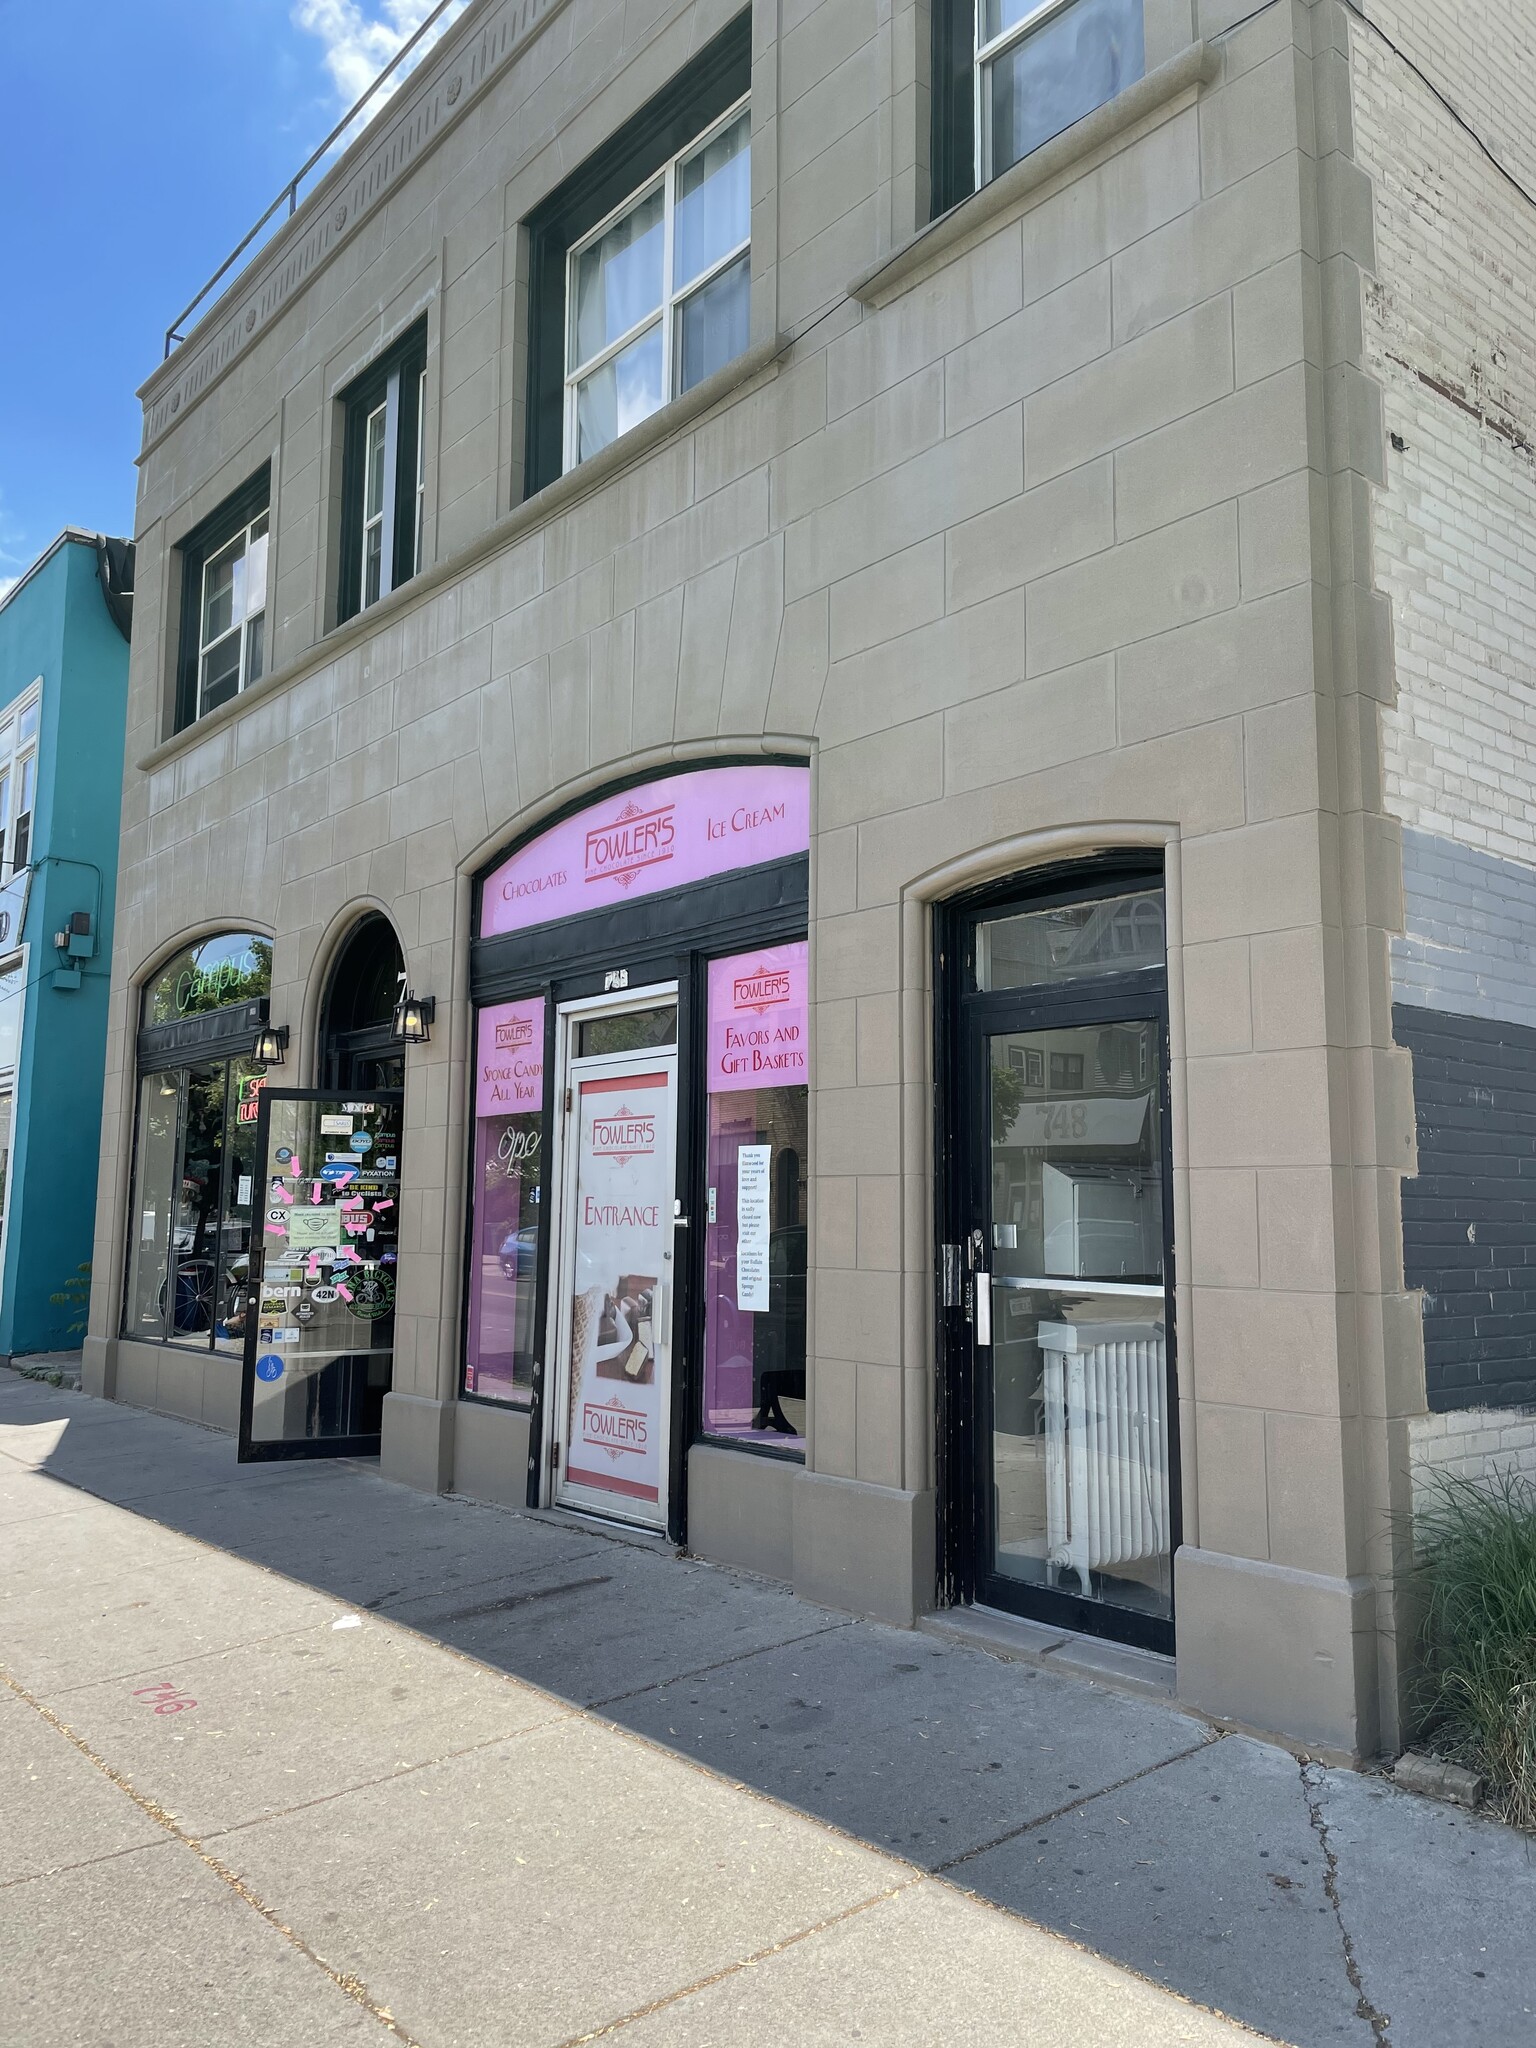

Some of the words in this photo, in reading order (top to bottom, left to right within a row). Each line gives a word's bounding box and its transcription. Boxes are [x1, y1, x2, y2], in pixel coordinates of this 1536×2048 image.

[708, 818, 726, 840] ICE
[732, 803, 784, 832] CREAM
[585, 815, 675, 869] FOWLER'S
[502, 870, 568, 900] CHOCOLATES
[176, 952, 253, 1011] Campus
[734, 976, 790, 1001] FOWLER'S
[496, 1022, 532, 1044] FOWLER'S
[726, 1028, 770, 1049] FAVORS
[773, 1026, 800, 1042] AND
[483, 1066, 512, 1083] SPONGE
[514, 1061, 543, 1078] CANDY
[721, 1052, 748, 1074] GIFT
[753, 1050, 804, 1072] BASKETS
[491, 1085, 510, 1101] ALL
[514, 1082, 535, 1100] YEAR
[592, 1120, 655, 1145] FOWLER'S
[1036, 1103, 1088, 1139] 748
[498, 1126, 542, 1176] Ope
[271, 1211, 286, 1220] CX
[341, 1214, 367, 1223] BUS
[584, 1196, 659, 1227] ENTRANCE
[262, 1286, 301, 1297] bern
[316, 1291, 334, 1299] 42N
[364, 1270, 396, 1302] BICYCLES
[583, 1403, 647, 1442] FOWLER'S
